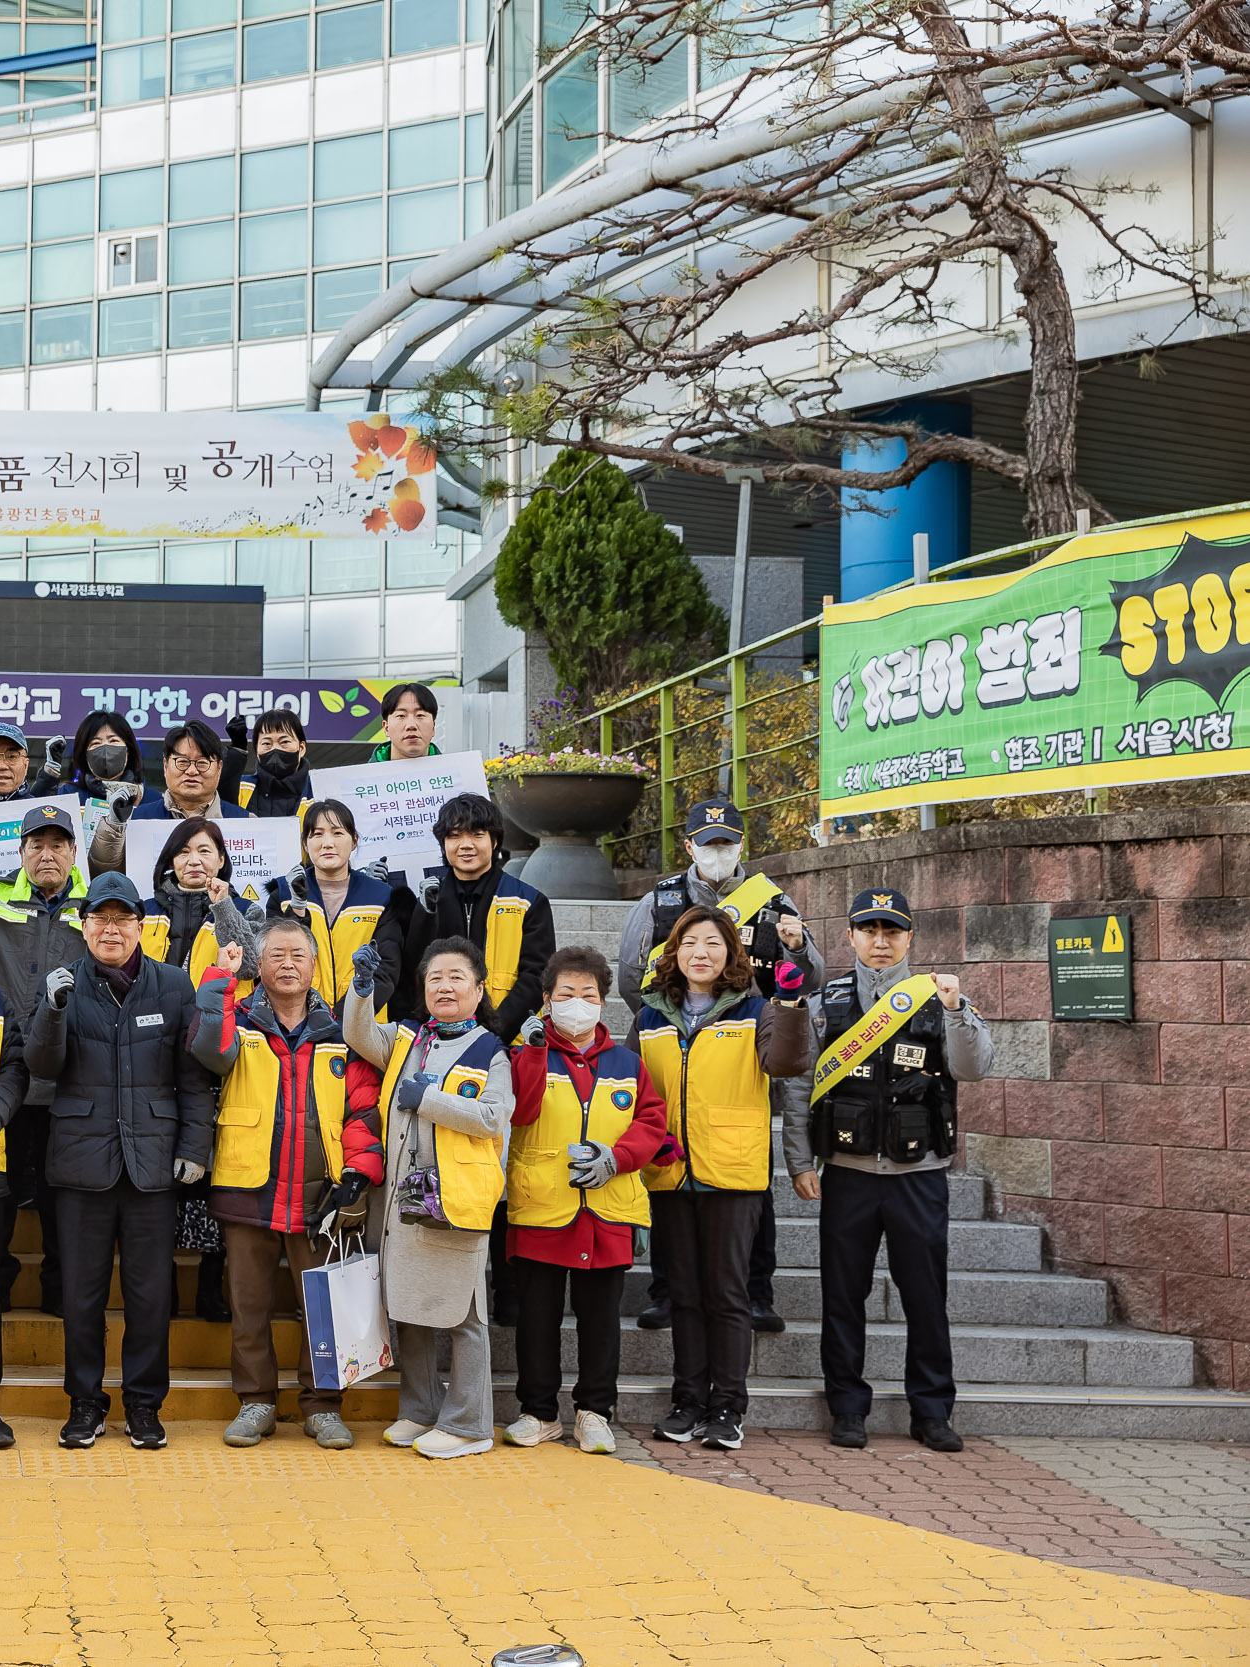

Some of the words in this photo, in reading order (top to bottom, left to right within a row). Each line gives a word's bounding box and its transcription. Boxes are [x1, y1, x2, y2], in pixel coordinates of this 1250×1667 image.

[42, 451, 140, 493] 전시회
[163, 464, 188, 492] 및
[202, 440, 333, 488] 공개수업
[51, 583, 124, 597] 서울광진초등학교
[861, 633, 968, 732] 어린이
[975, 606, 1082, 710] 범죄
[80, 686, 191, 730] 건강한
[200, 689, 311, 727] 어린이
[1004, 736, 1042, 773] 협조
[1045, 728, 1085, 766] 기관
[1116, 711, 1235, 757] 서울시청
[355, 784, 379, 798] 우리
[386, 779, 422, 794] 아이의
[429, 775, 454, 790] 안전
[369, 800, 400, 813] 모두의
[405, 795, 445, 810] 관심에서
[384, 812, 437, 828] 시작됩니다!
[223, 839, 255, 851] 취범죄
[230, 854, 267, 866] 입니다.
[236, 869, 272, 877] 신고하세요!
[858, 1011, 892, 1043] 주민과
[838, 1039, 863, 1062] 함께
[897, 1057, 920, 1066] POLICE
